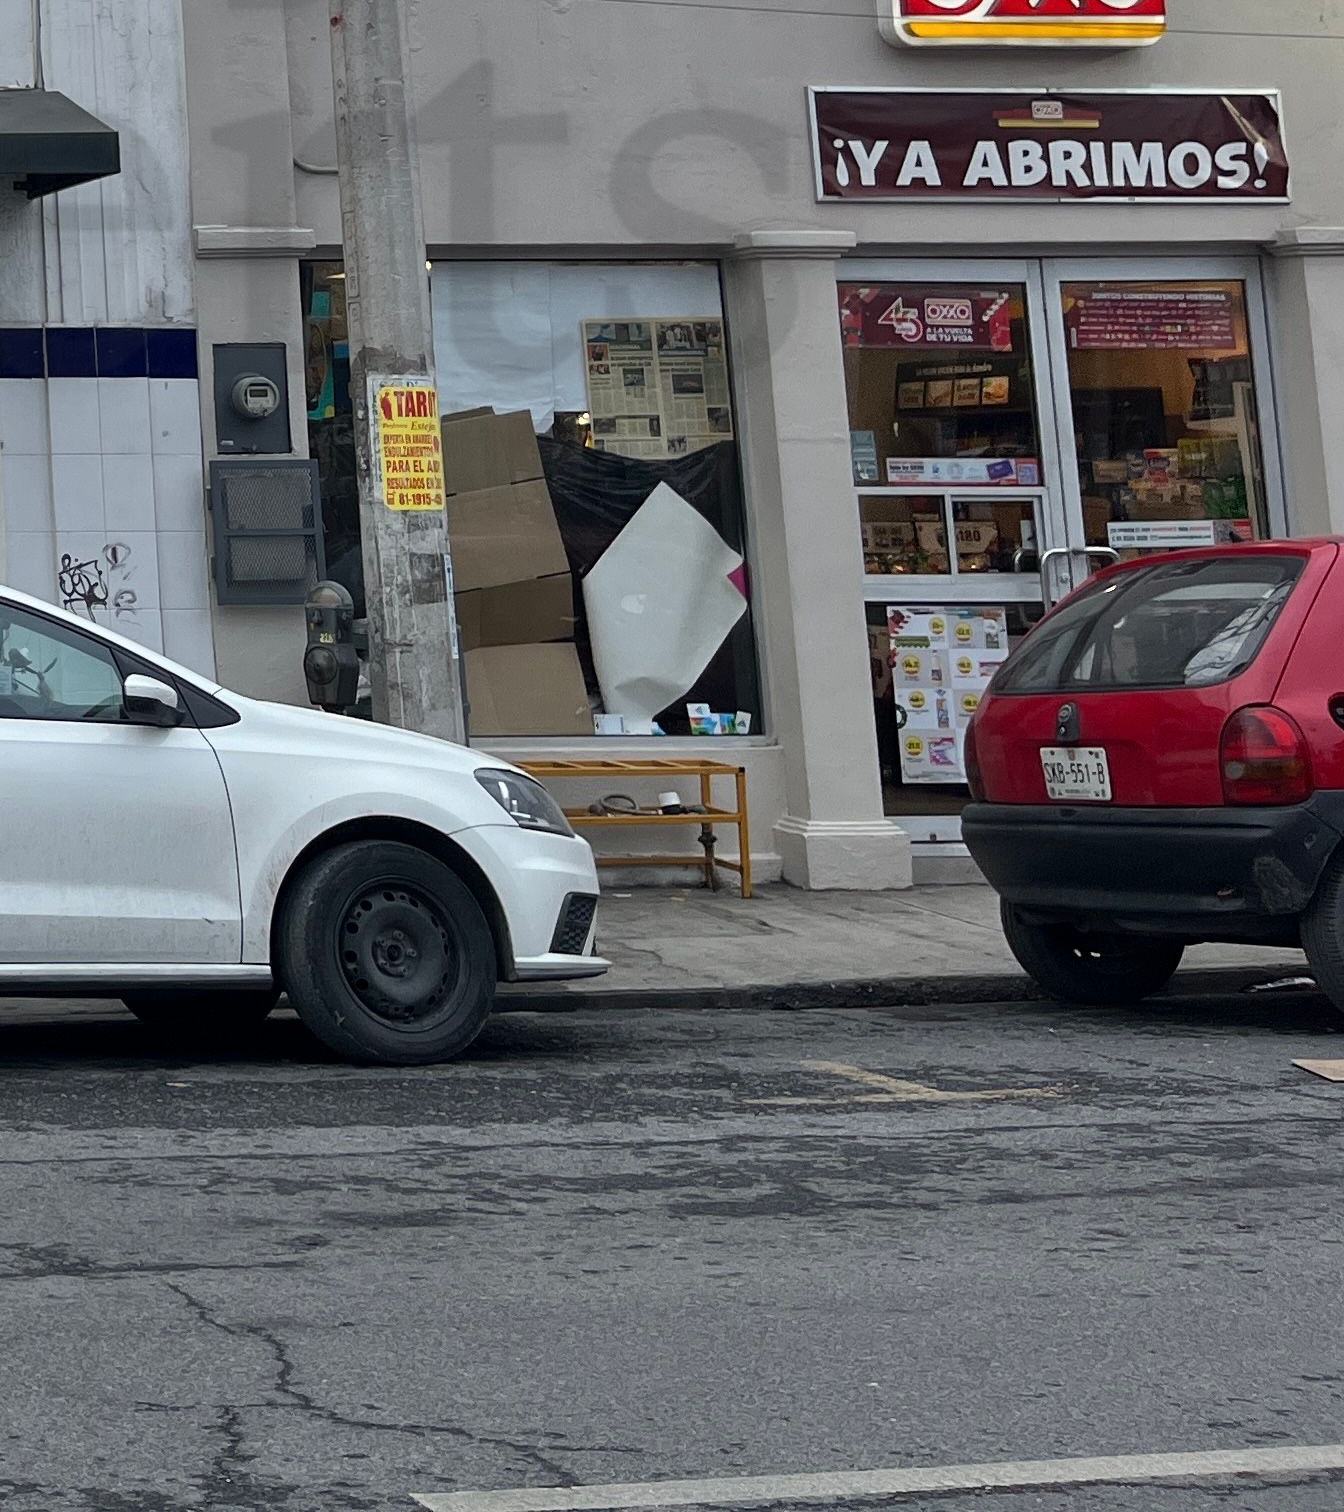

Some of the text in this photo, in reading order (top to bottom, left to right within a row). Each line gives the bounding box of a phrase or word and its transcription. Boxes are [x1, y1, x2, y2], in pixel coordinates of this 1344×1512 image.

[962, 139, 1270, 191] ABRIMOS!
[927, 303, 970, 321] OXXO
[386, 459, 411, 473] PARA
[413, 460, 425, 473] EL
